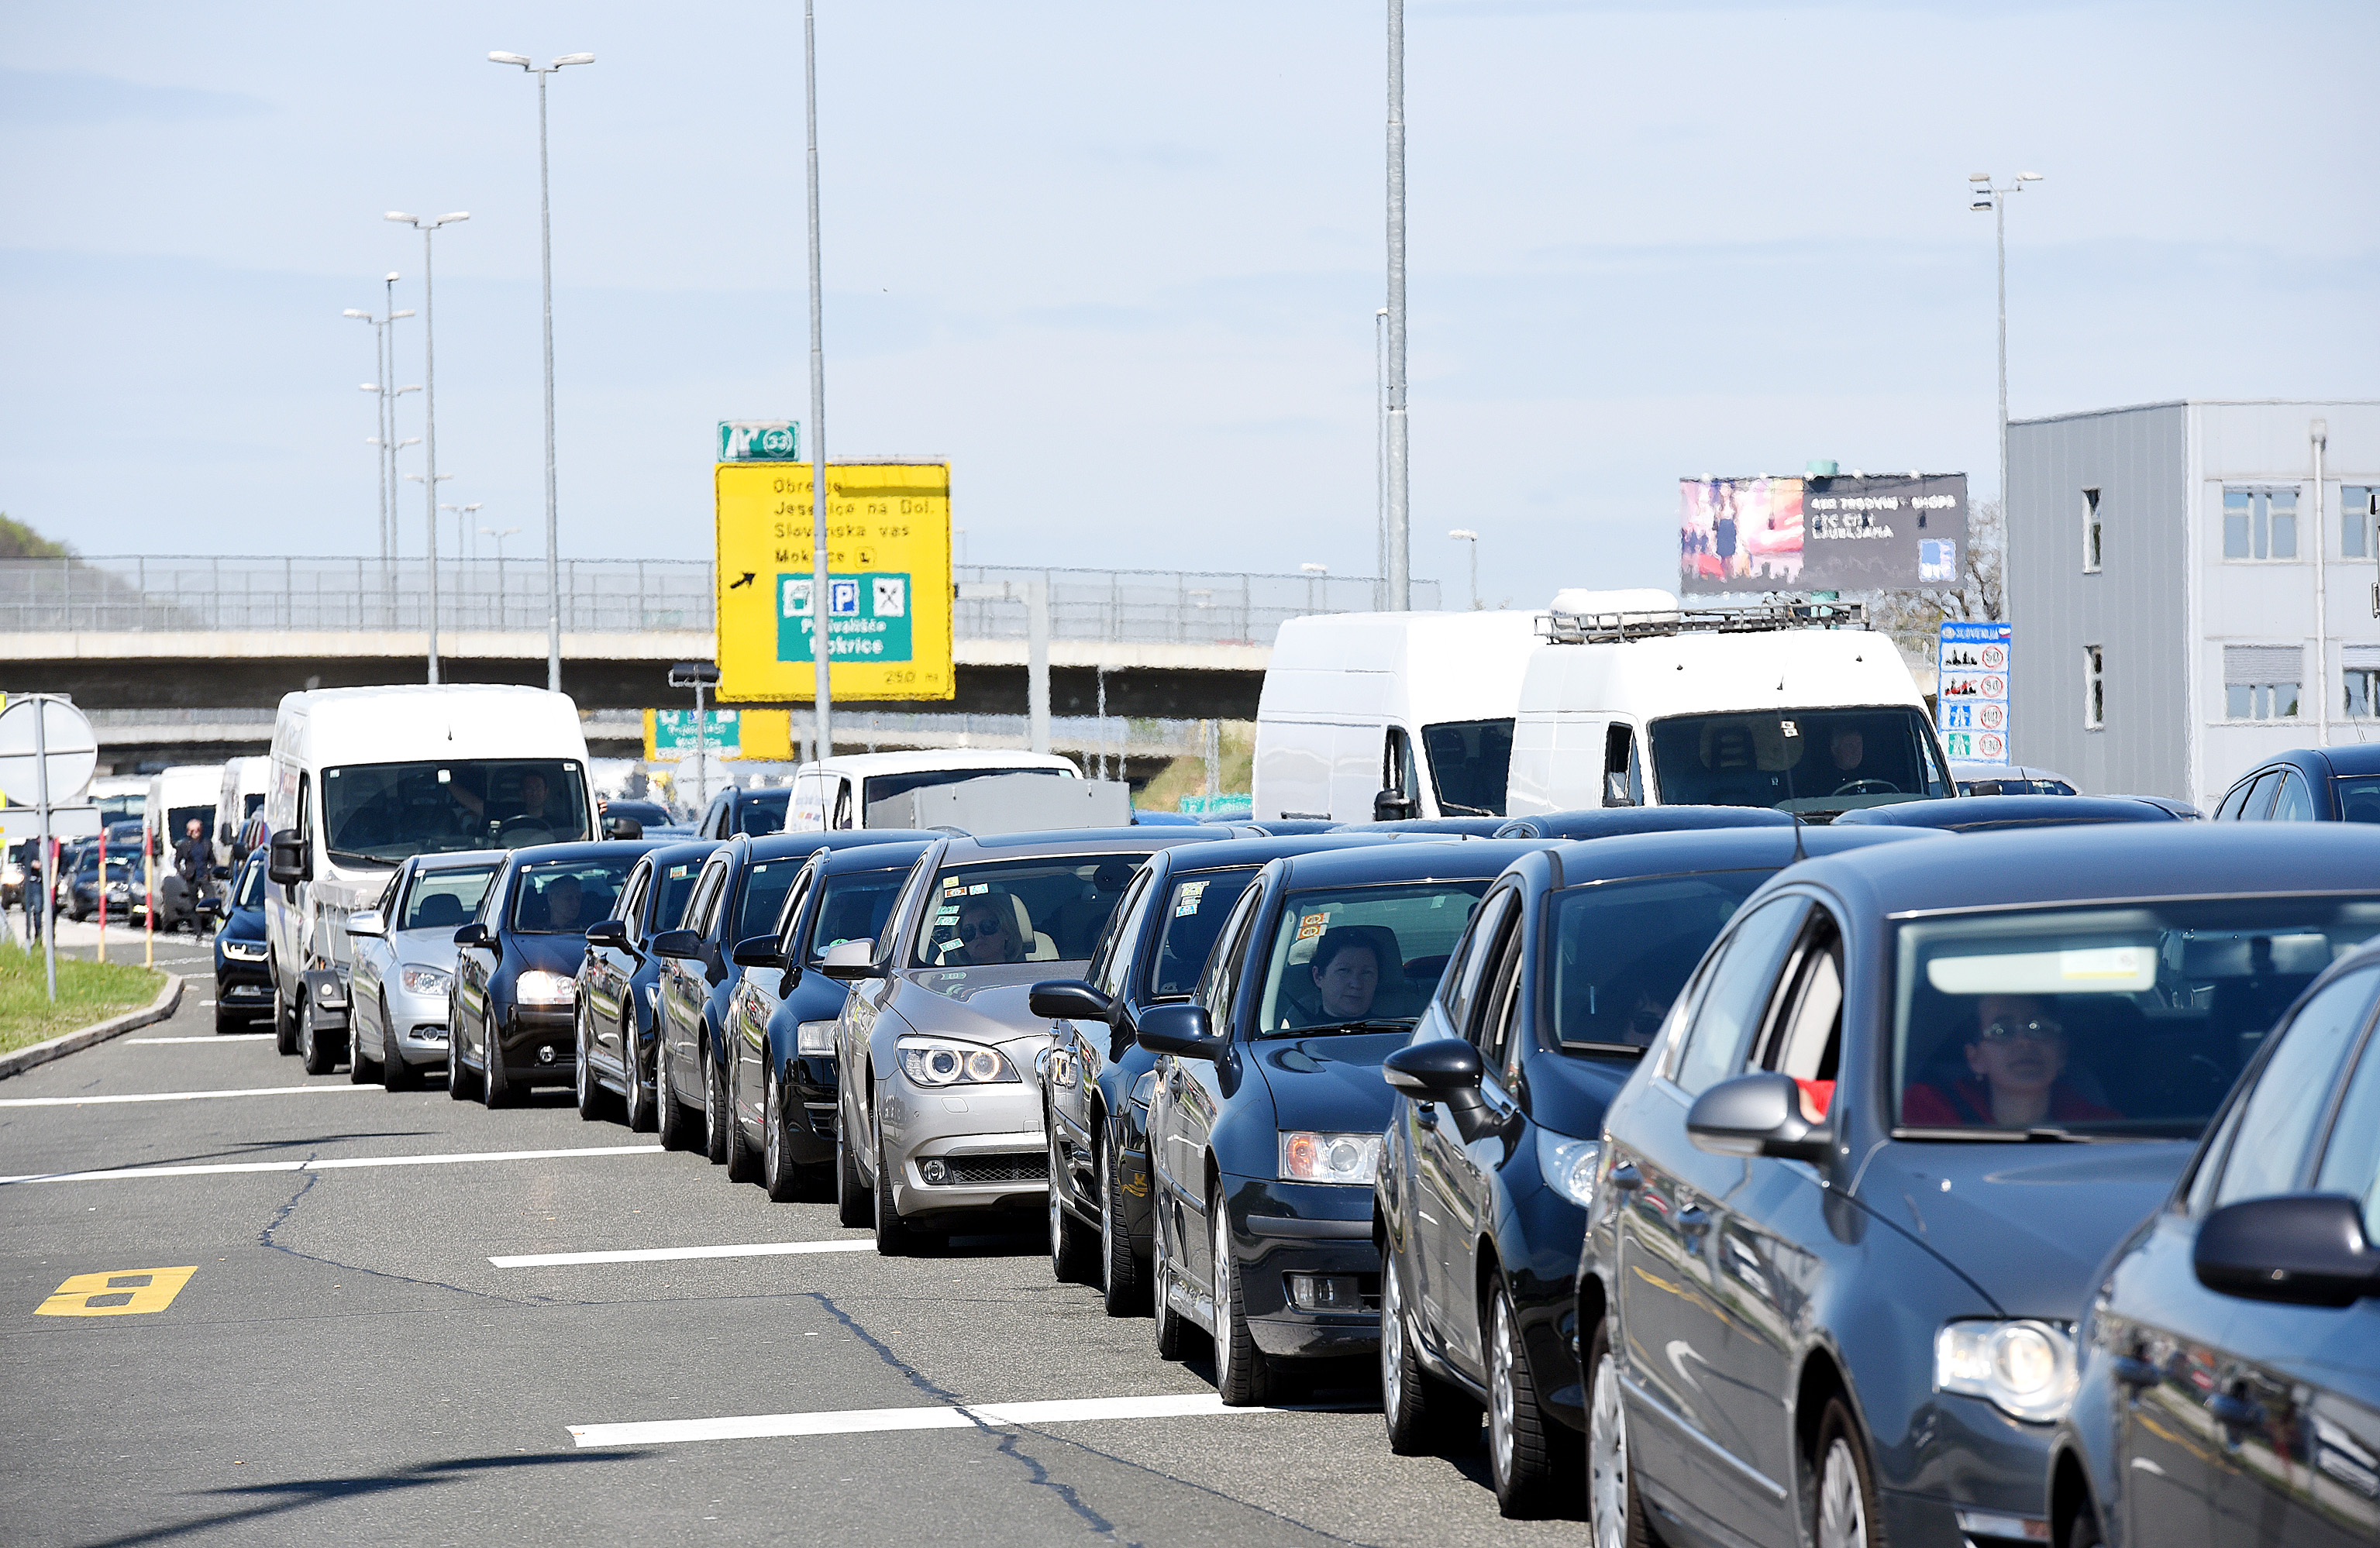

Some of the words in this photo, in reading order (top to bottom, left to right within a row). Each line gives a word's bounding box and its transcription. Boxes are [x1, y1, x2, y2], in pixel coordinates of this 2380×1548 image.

[768, 434, 789, 450] 33
[774, 479, 841, 496] Obreje
[773, 500, 855, 516] Jeseice
[867, 503, 888, 515] na
[901, 499, 935, 515] Dol.
[773, 522, 866, 538] Slovnska
[878, 526, 910, 538] vas
[1812, 525, 1895, 539] LJUBLJANA
[775, 547, 846, 563] Mokce
[1955, 627, 1999, 639] SLOVENIJA
[1986, 652, 1999, 662] 50
[1986, 679, 1999, 690] 90
